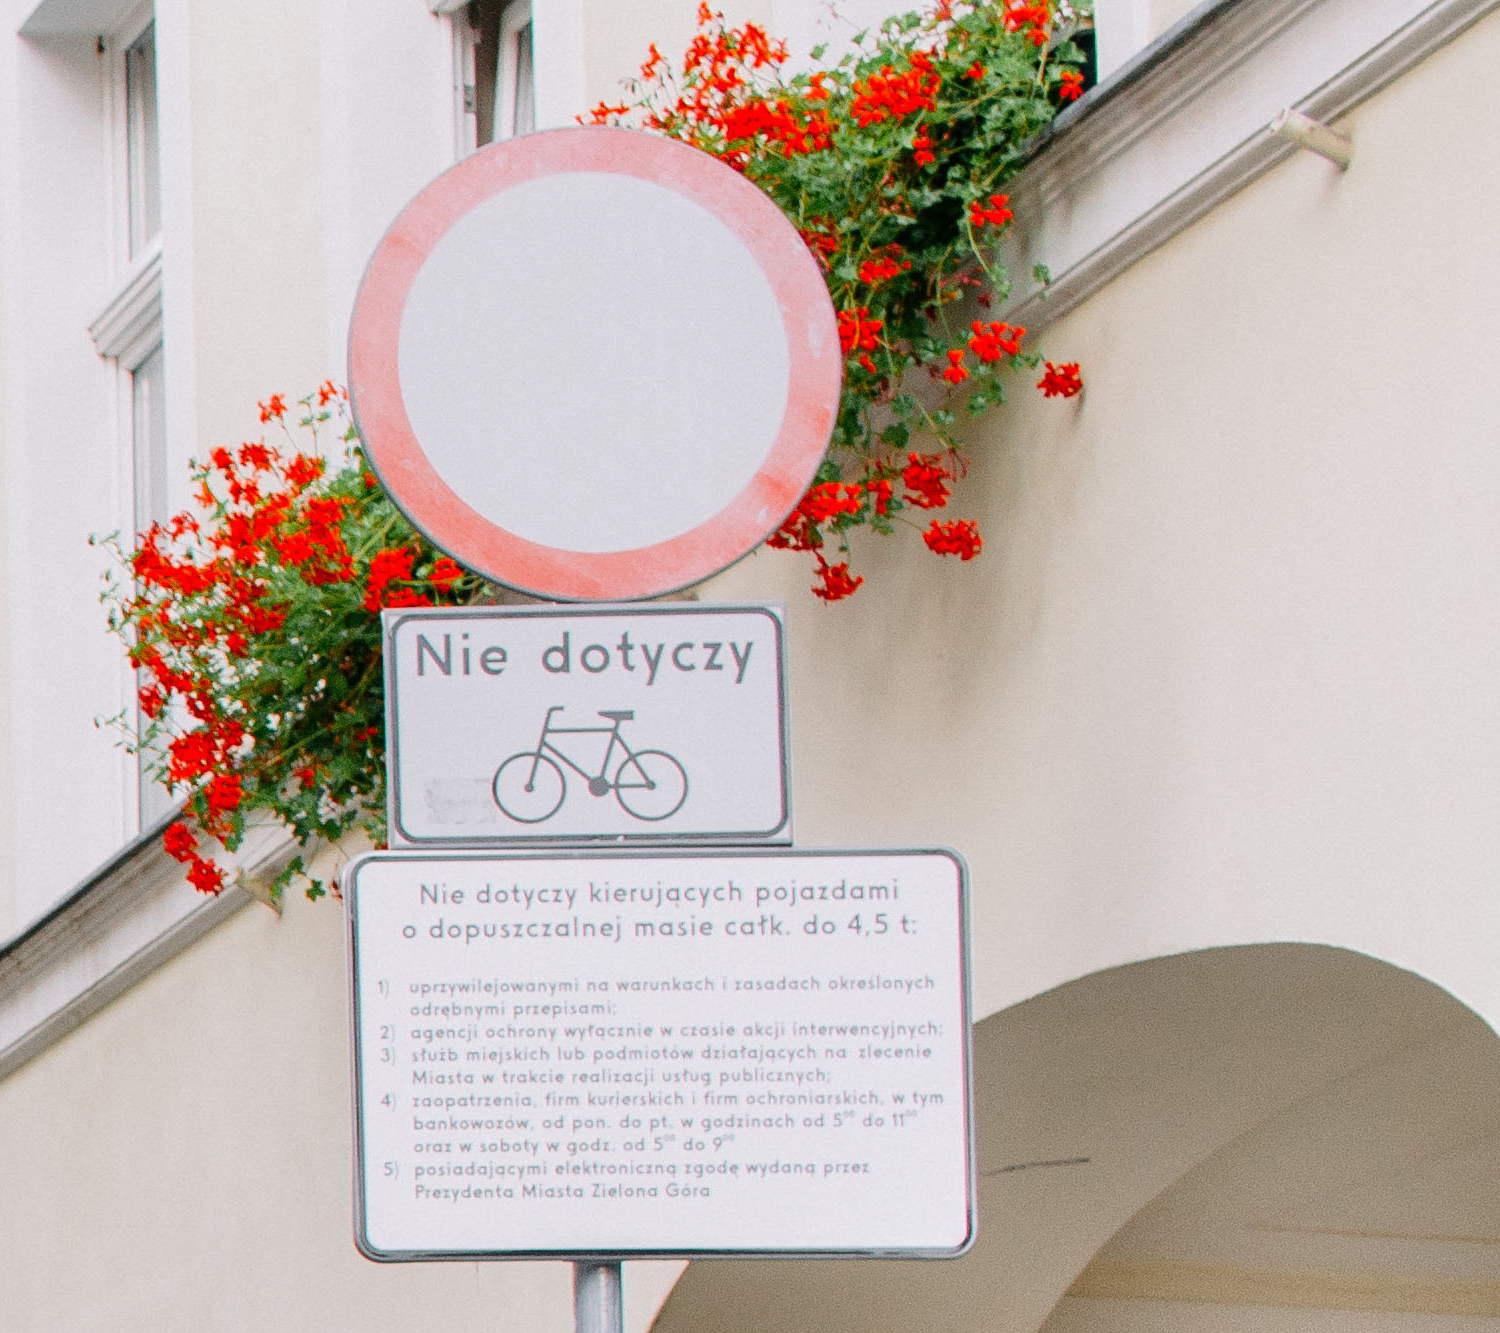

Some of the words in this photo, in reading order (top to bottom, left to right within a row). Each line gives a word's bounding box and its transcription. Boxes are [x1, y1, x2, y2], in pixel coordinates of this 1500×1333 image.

[416, 632, 510, 677] Nie
[542, 629, 756, 687] dotyczy
[419, 883, 466, 905] Nie
[475, 883, 578, 910] dotyczy
[588, 880, 743, 908] kierujących
[755, 878, 899, 908] pojazdami
[428, 916, 622, 945] dopuszczalnej
[634, 915, 714, 937] masie
[724, 914, 791, 936] całk.
[802, 914, 837, 935] do
[846, 913, 889, 937] 4,5
[899, 915, 917, 934] t:
